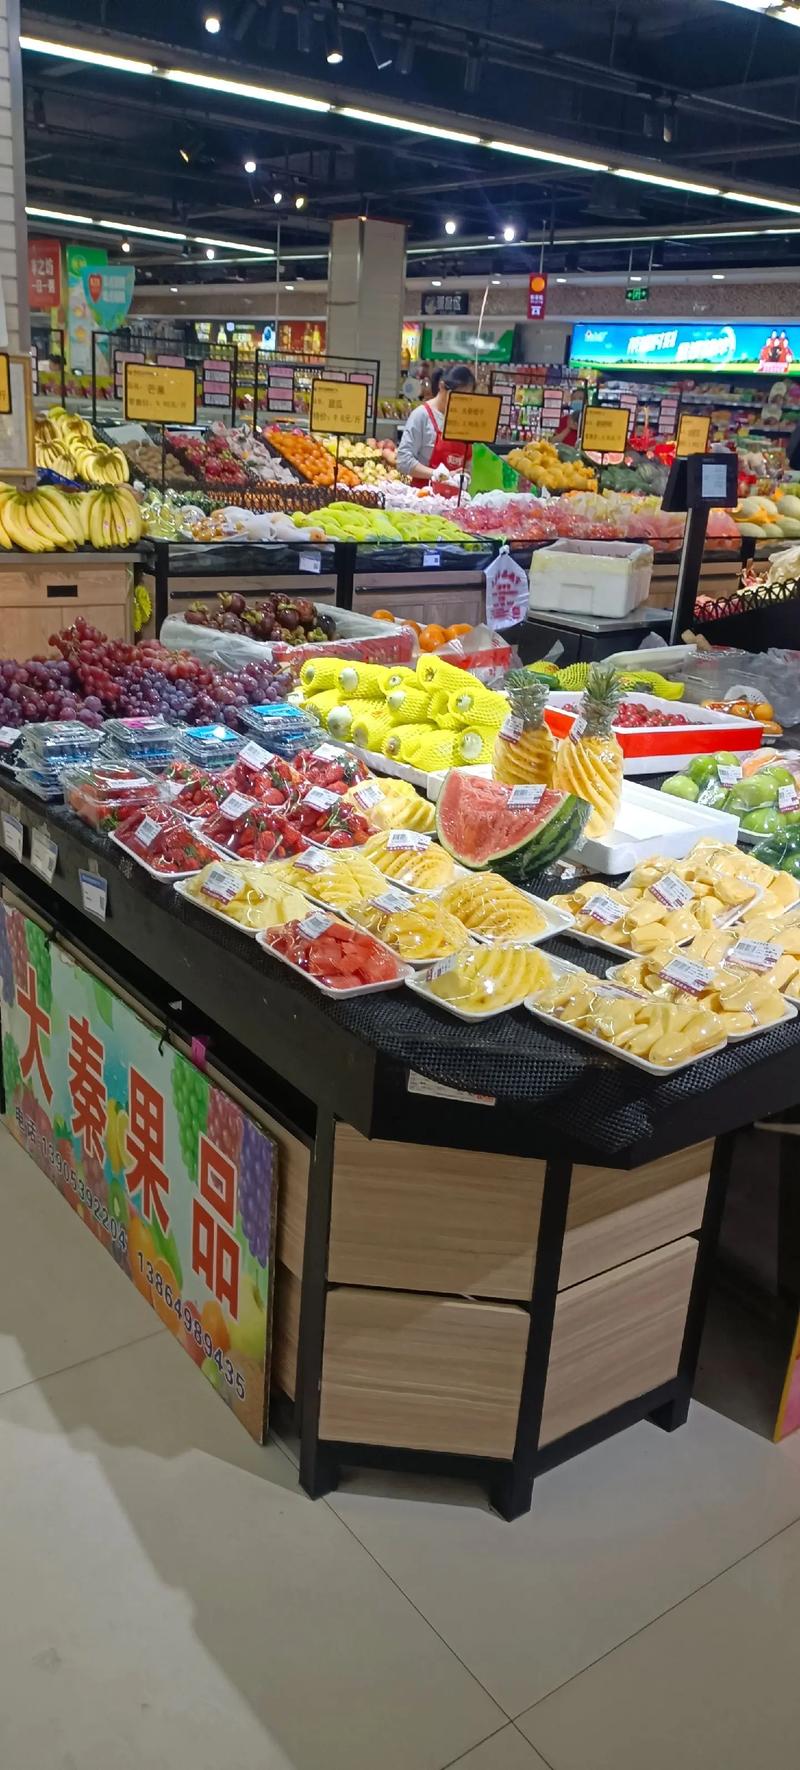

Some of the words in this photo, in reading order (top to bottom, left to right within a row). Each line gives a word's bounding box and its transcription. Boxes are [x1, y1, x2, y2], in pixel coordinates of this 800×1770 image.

[16, 962, 240, 1321] 大秦果品
[41, 1136, 128, 1251] 13905392204
[138, 1251, 245, 1401] 13864989435
